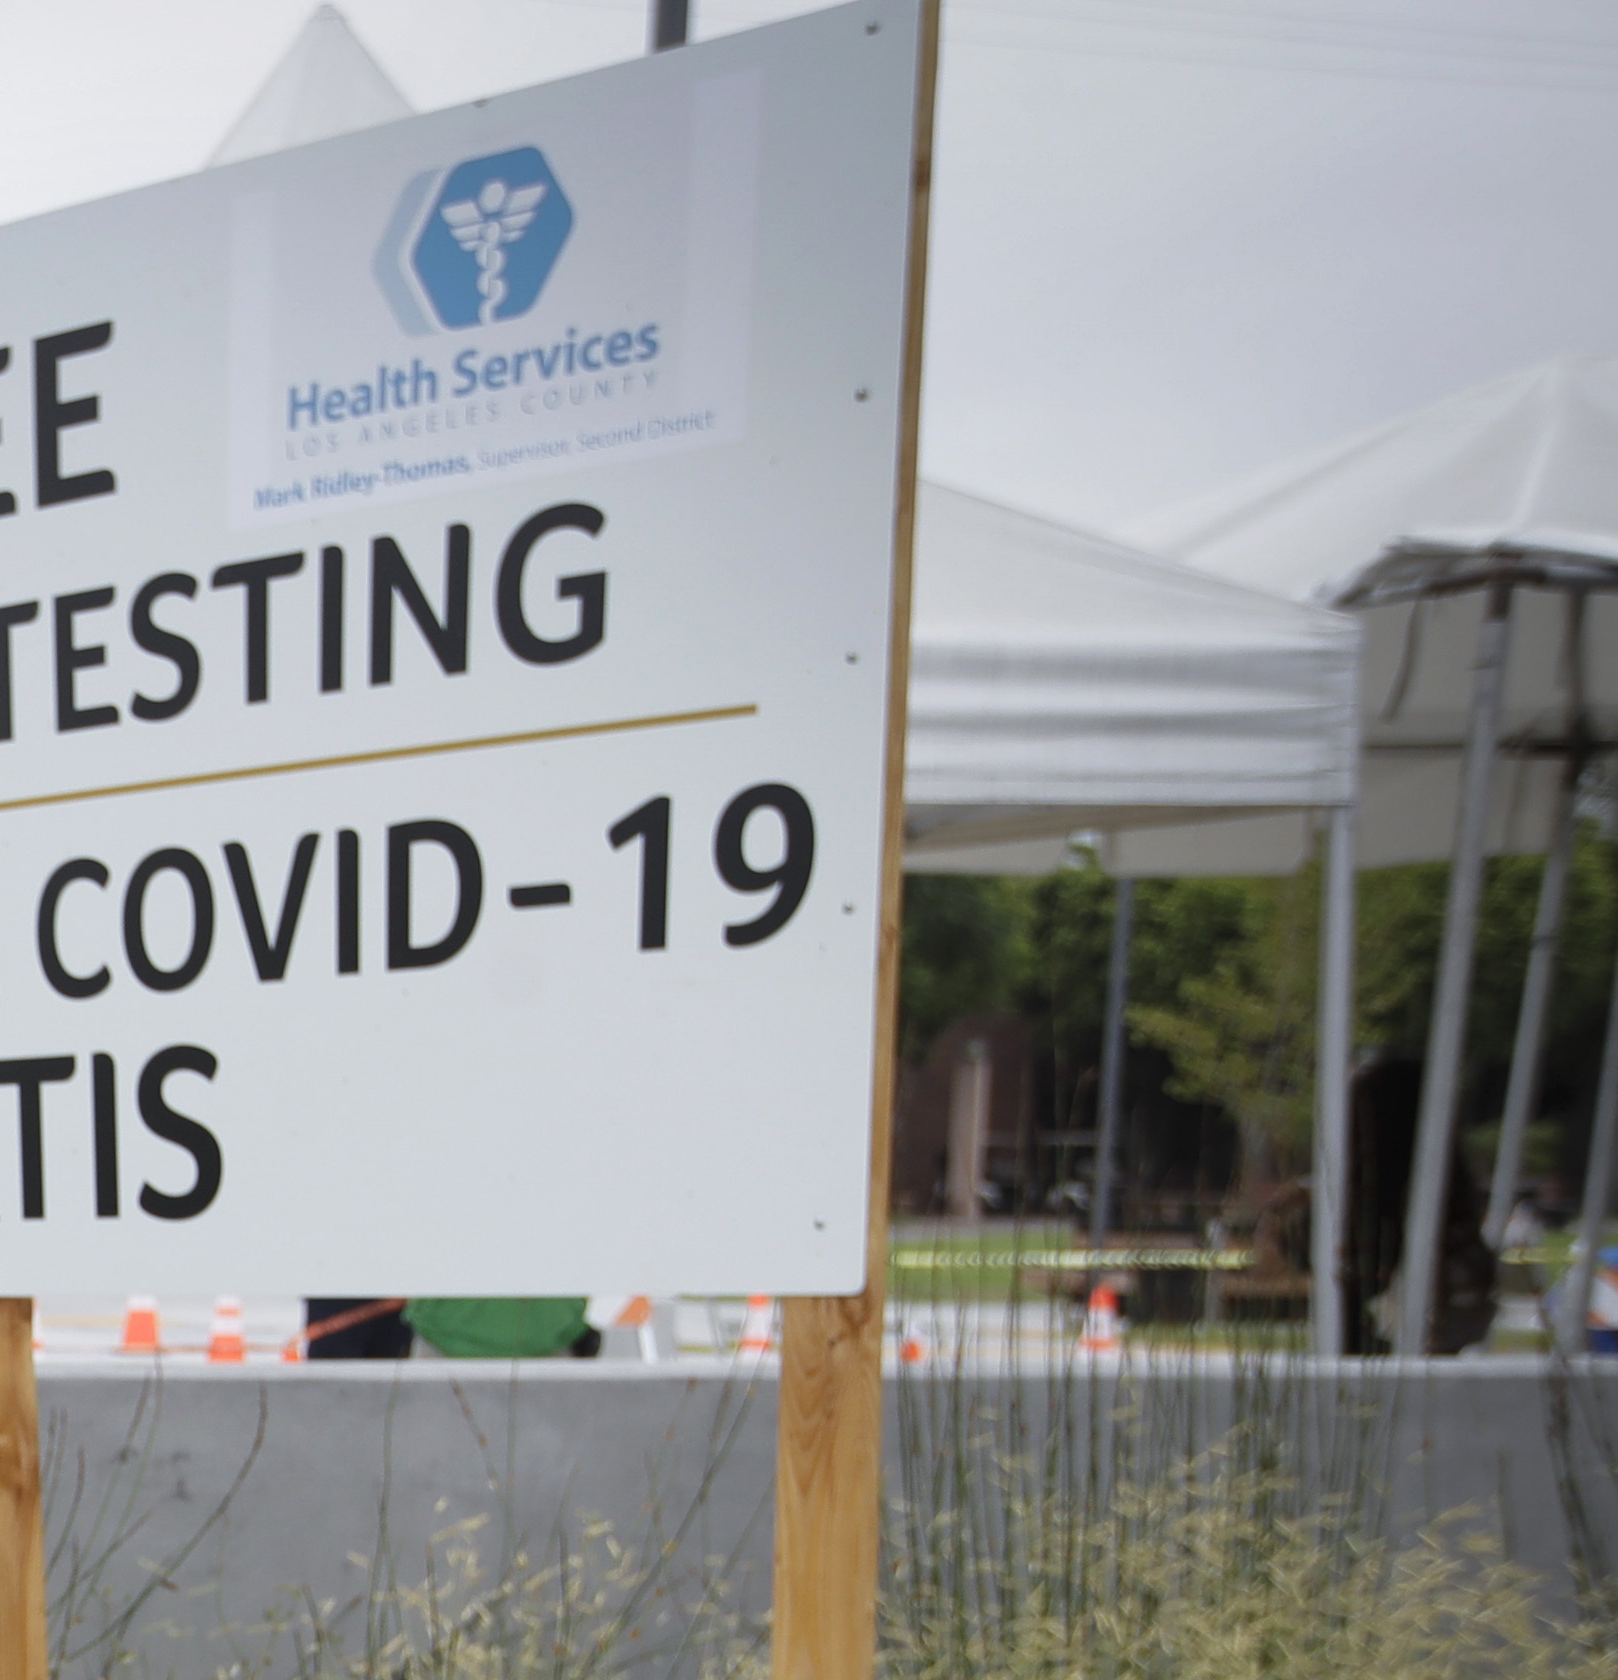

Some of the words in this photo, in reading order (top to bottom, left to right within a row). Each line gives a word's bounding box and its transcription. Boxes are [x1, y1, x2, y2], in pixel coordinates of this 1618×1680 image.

[285, 434, 339, 461] LOS
[363, 401, 499, 441] ANGELES
[521, 371, 658, 415] COUNTY
[287, 359, 438, 431] Health
[453, 323, 660, 397] Services
[254, 484, 306, 509] Mark
[576, 421, 643, 453] Second
[647, 409, 717, 438] District
[35, 781, 817, 1000] COVID-19
